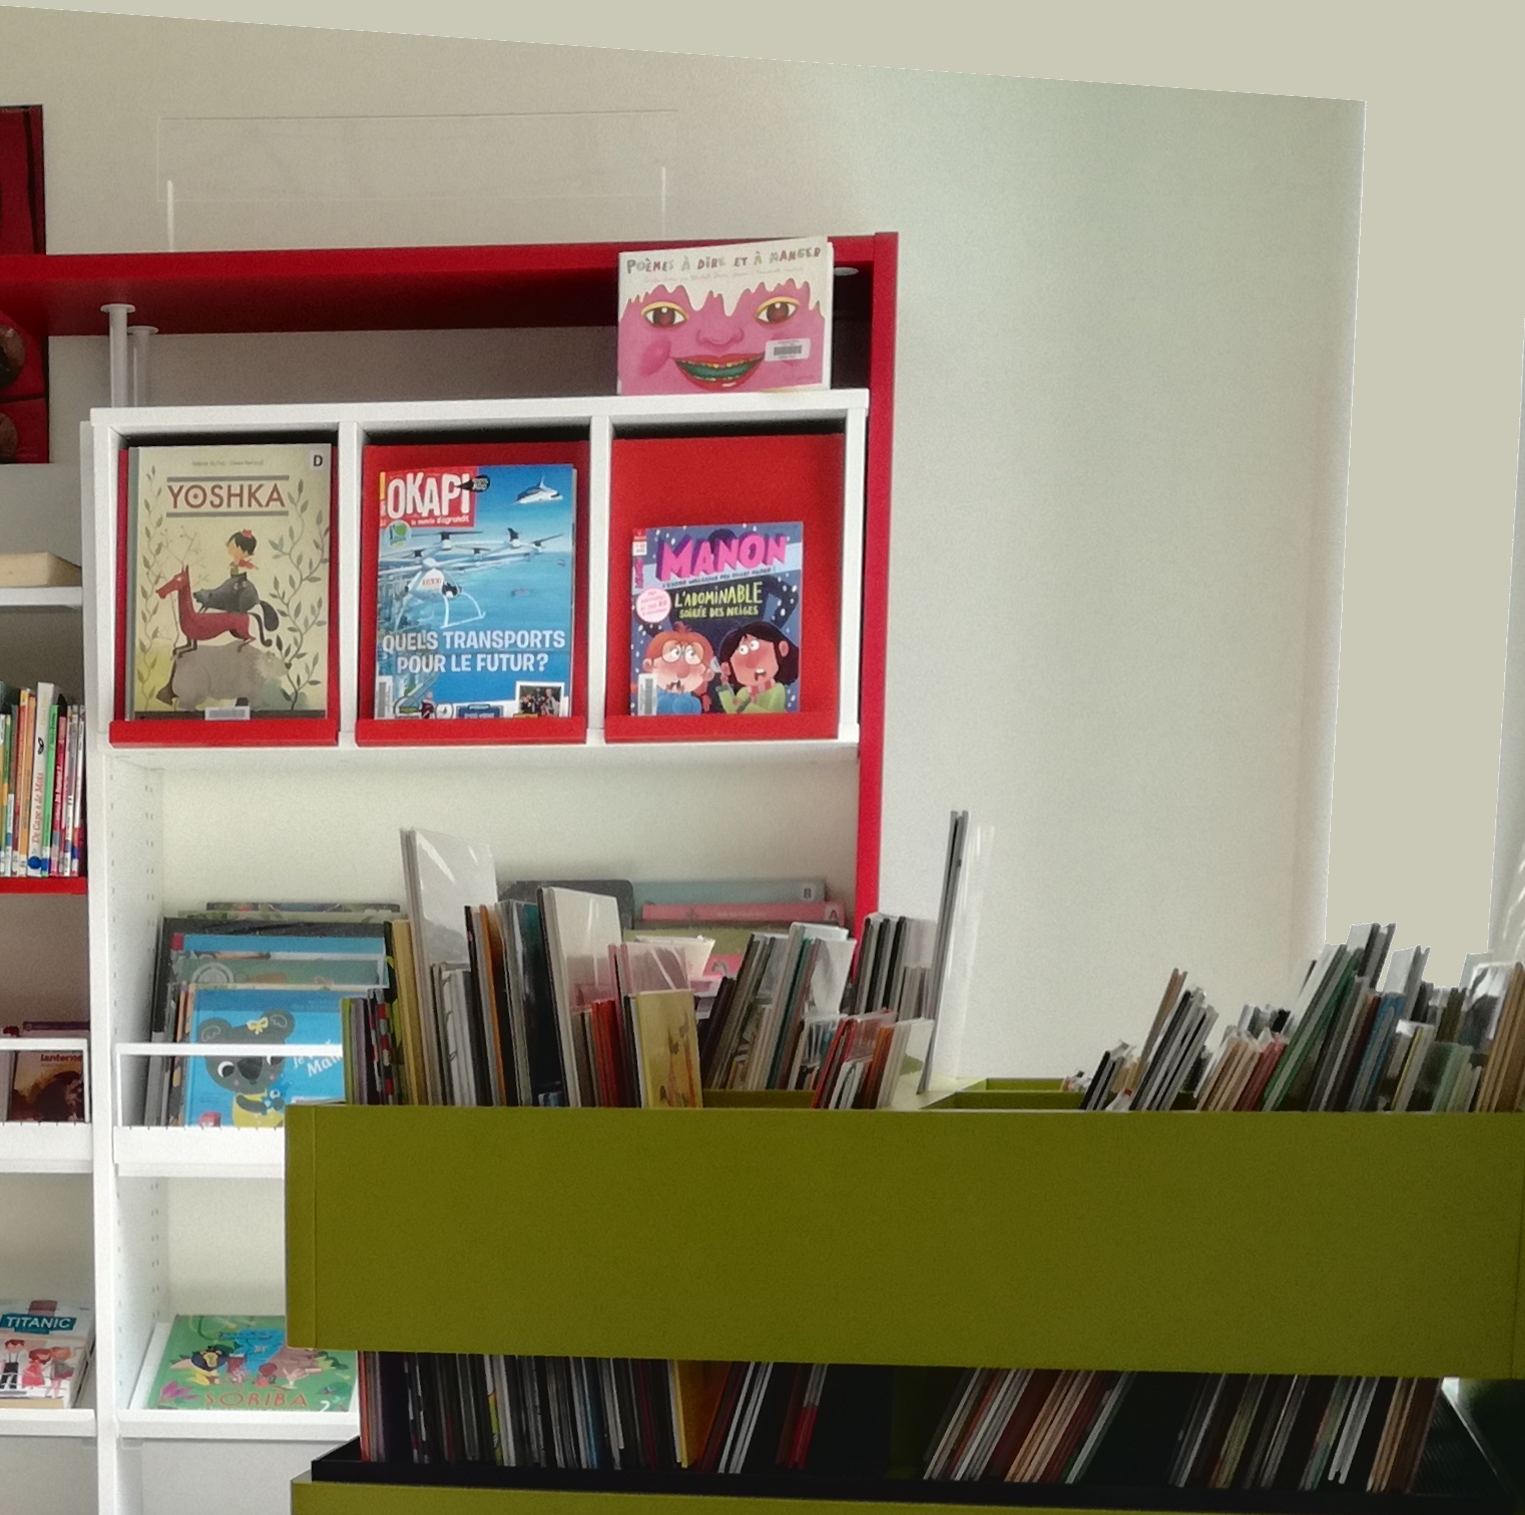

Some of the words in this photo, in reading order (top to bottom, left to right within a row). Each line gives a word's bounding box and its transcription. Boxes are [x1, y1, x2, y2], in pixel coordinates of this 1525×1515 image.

[733, 257, 748, 267] ET
[769, 247, 821, 263] MANGER
[313, 454, 324, 467] D
[167, 483, 286, 509] YOSHKA
[387, 472, 471, 519] OKAPI
[656, 533, 787, 581] MANON
[674, 581, 763, 608] L'ABOMINABLE
[709, 606, 724, 618] DES
[726, 604, 758, 617] NEIGES
[382, 631, 439, 651] QUELS
[443, 630, 566, 649] TRANSPORTS
[397, 654, 446, 674] POUR
[451, 654, 471, 672] LE
[6, 1315, 71, 1329] TITANIC
[205, 1392, 308, 1407] SORIBA
